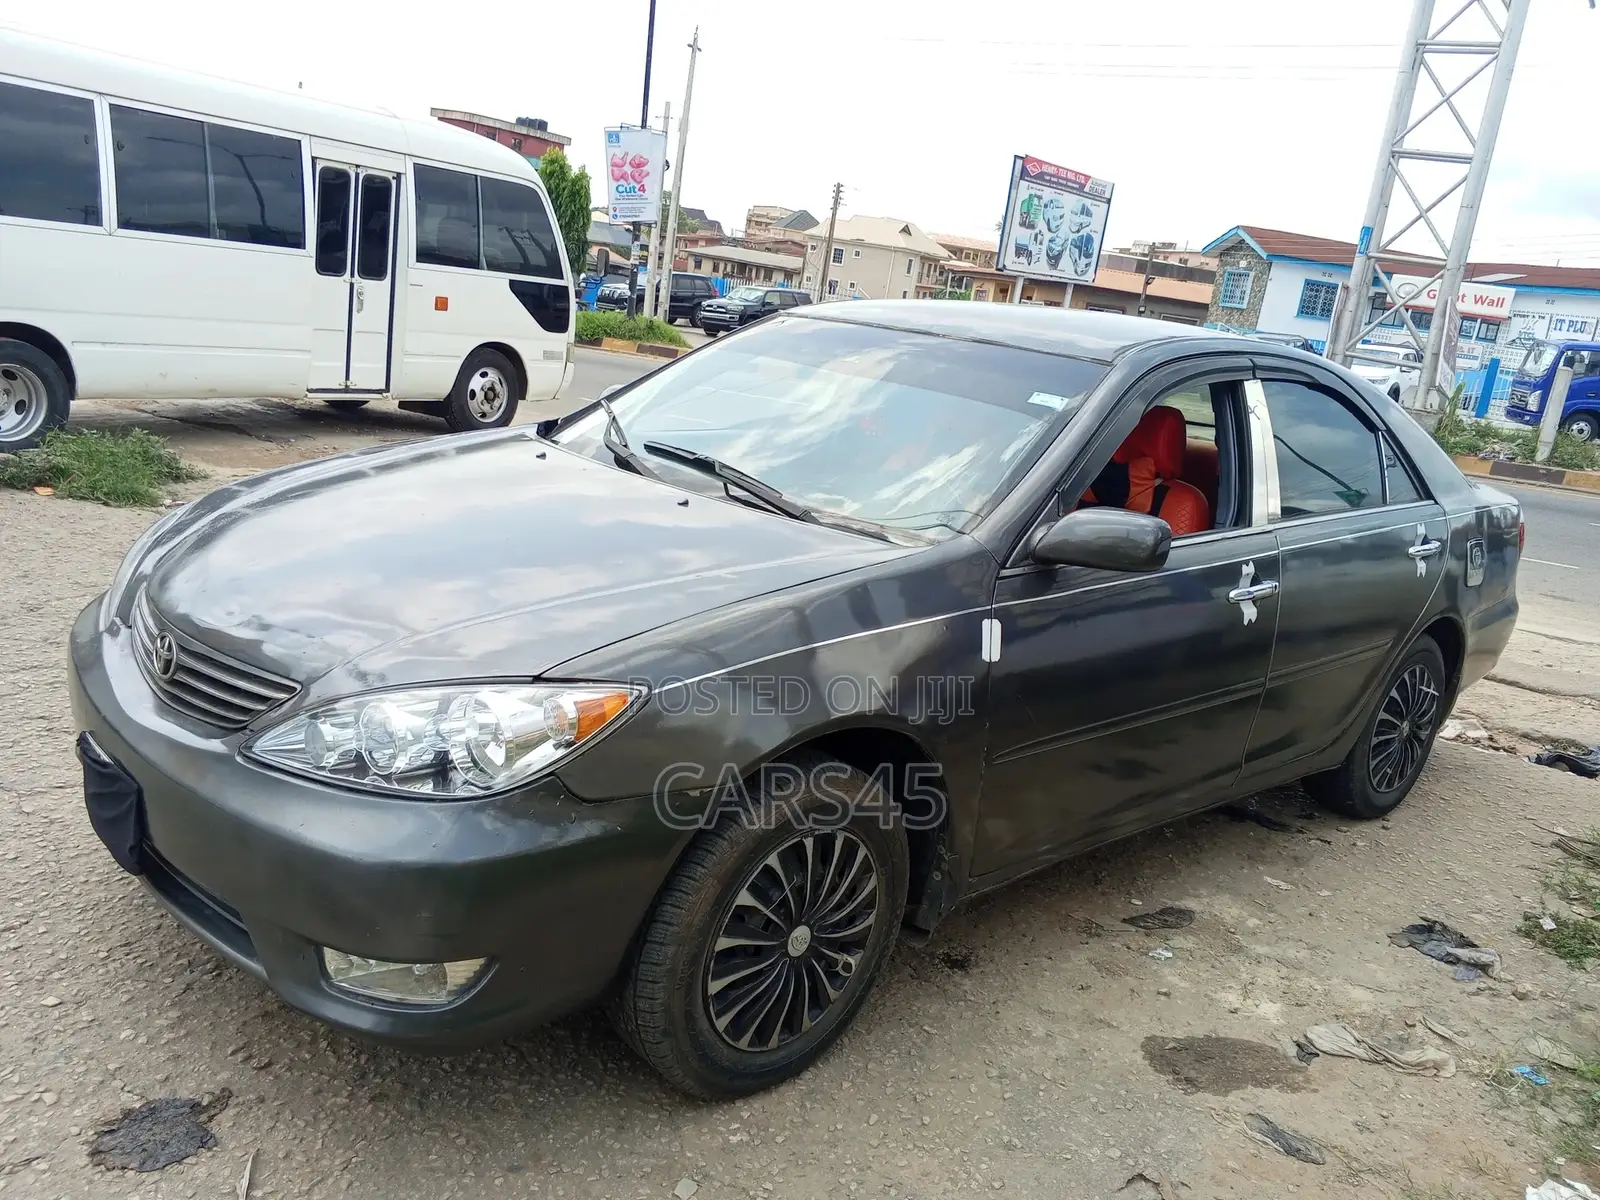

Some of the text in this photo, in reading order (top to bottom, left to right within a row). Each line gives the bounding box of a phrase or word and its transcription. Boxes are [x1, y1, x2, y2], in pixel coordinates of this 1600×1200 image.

[1088, 185, 1107, 197] DEALER
[1473, 294, 1505, 308] Wall
[1554, 318, 1566, 331] IT
